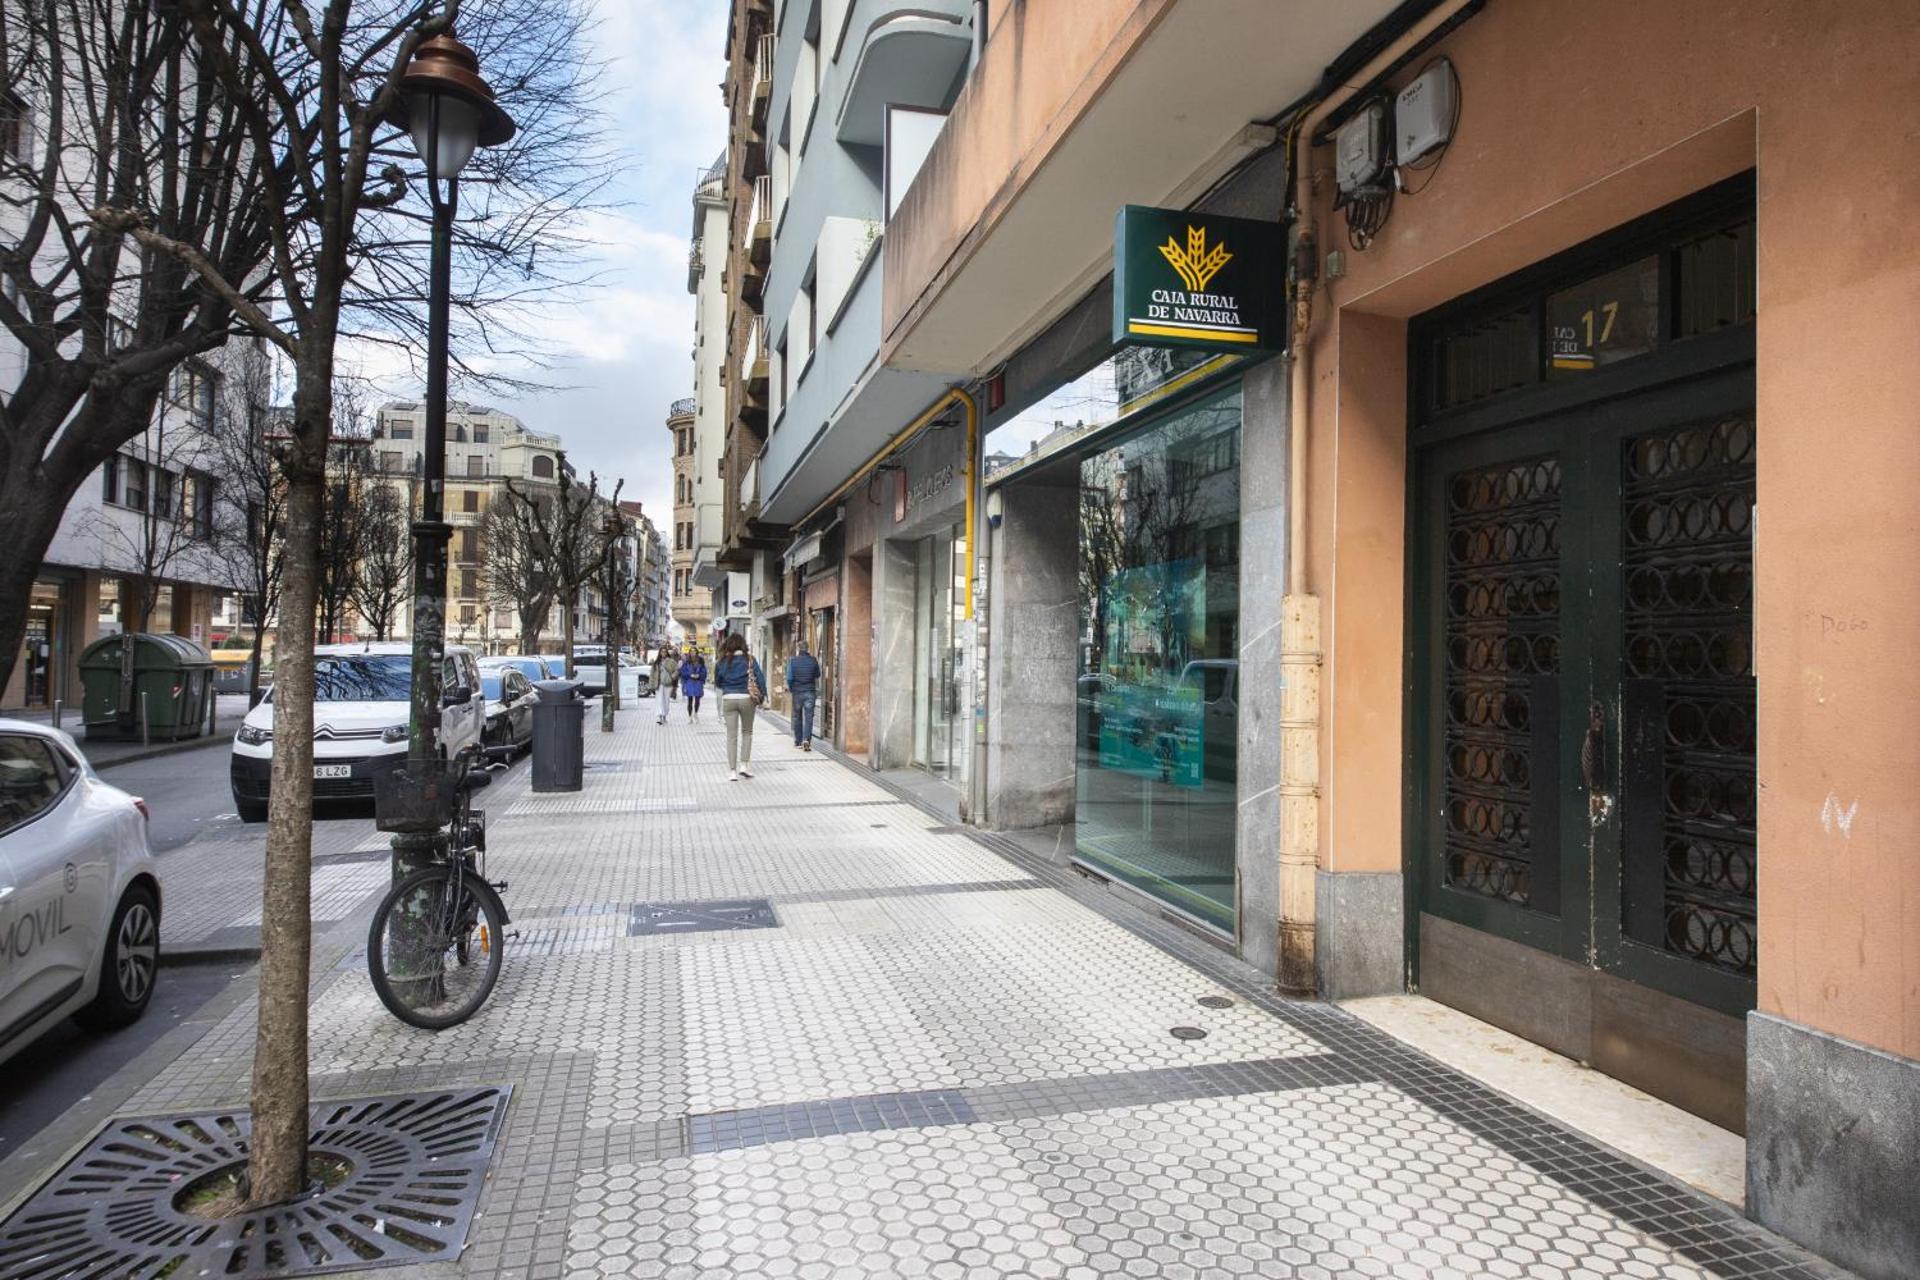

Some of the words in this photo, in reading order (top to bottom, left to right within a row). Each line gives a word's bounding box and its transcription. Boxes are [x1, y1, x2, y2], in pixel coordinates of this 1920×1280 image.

[1152, 290, 1186, 305] CAJA
[1190, 293, 1238, 309] RURAL
[1148, 304, 1169, 318] DE
[1174, 307, 1240, 325] NAVARRA
[1582, 301, 1618, 347] 17
